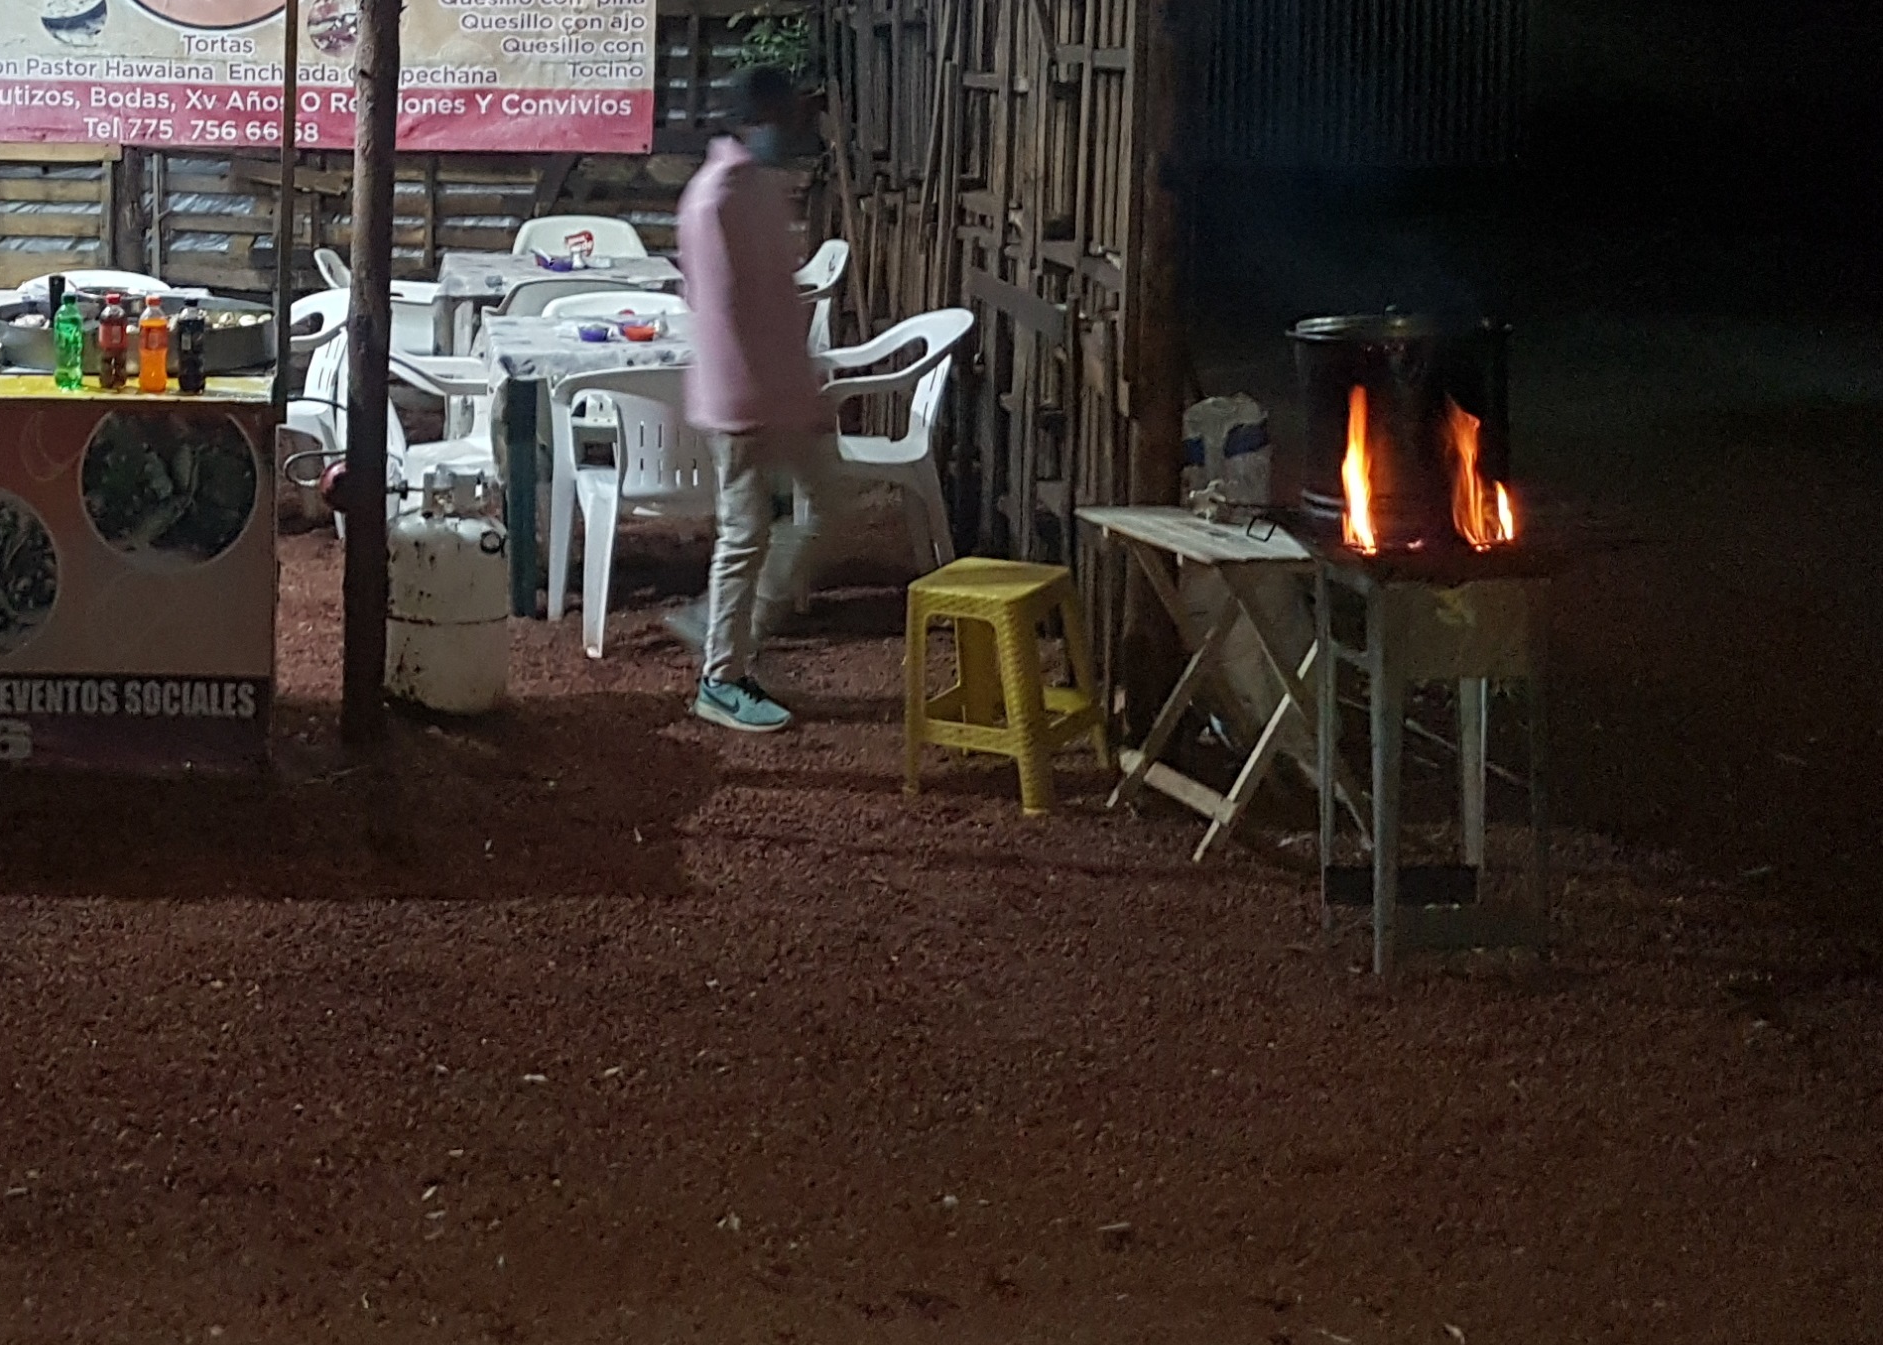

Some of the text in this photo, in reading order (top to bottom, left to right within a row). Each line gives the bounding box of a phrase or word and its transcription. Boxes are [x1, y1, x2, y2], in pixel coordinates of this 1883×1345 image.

[461, 13, 646, 34] Quesillo con ajo
[183, 34, 253, 55] Tortas
[502, 37, 646, 55] Quesillo con
[26, 58, 97, 77] Pastor
[105, 59, 214, 81] Hawaiana
[229, 62, 339, 84] Enchada
[568, 62, 645, 79] Tocino
[90, 88, 177, 113] Bodas,
[185, 91, 217, 111] Xv
[300, 92, 321, 114] O
[330, 92, 467, 115] Reiones
[475, 94, 494, 115] Y
[501, 93, 633, 117] Convivios
[127, 118, 174, 140] 775
[190, 120, 238, 141] 756
[123, 680, 257, 718] SOCIALES
